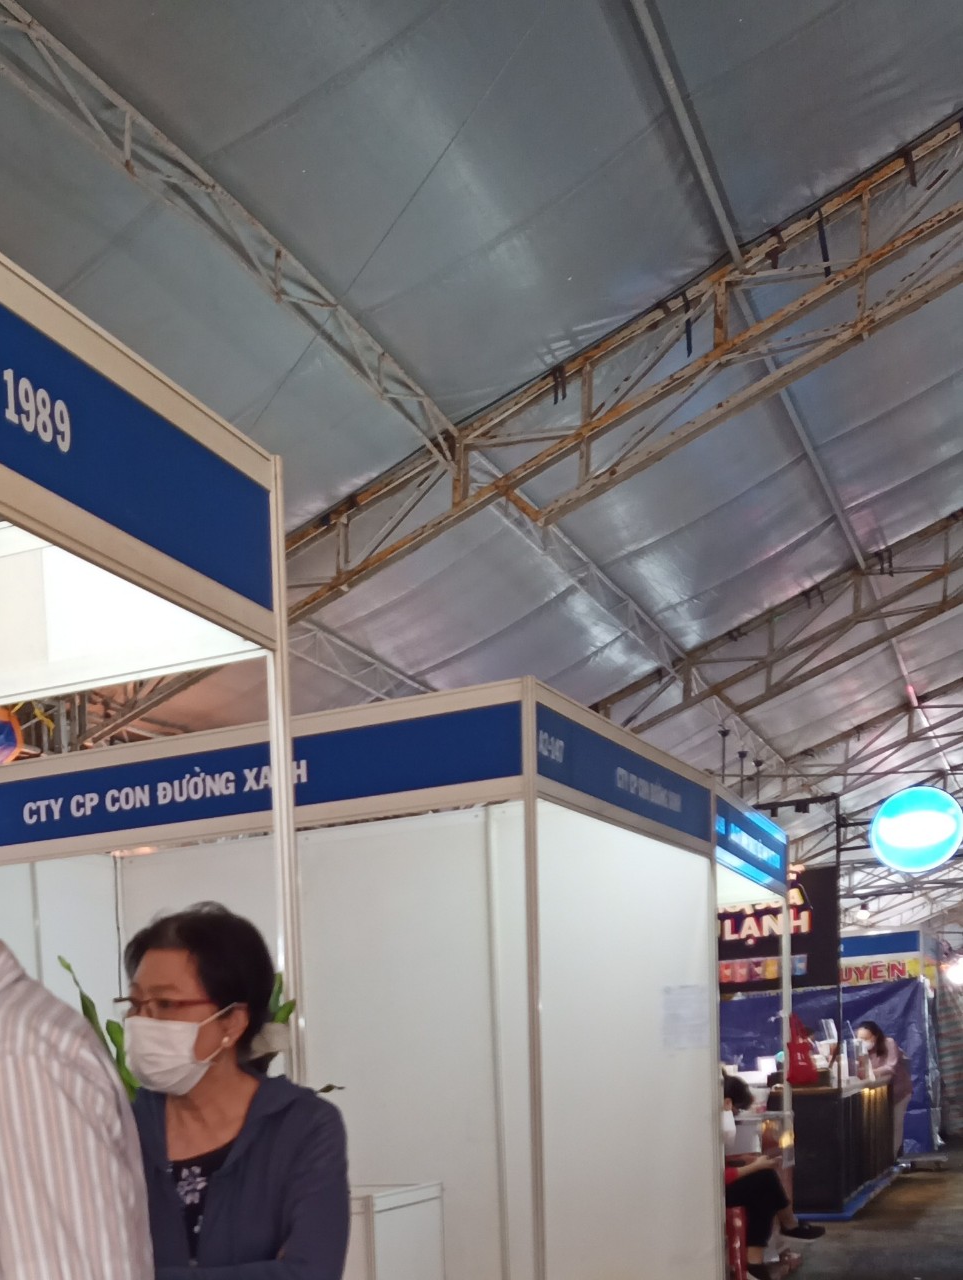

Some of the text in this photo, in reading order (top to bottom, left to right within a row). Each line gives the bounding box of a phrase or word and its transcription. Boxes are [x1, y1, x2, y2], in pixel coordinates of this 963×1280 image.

[3, 368, 72, 453] 1989
[22, 760, 307, 825] CTY CP CON ĐƯỜNG XAH
[724, 909, 812, 945] LẠNH
